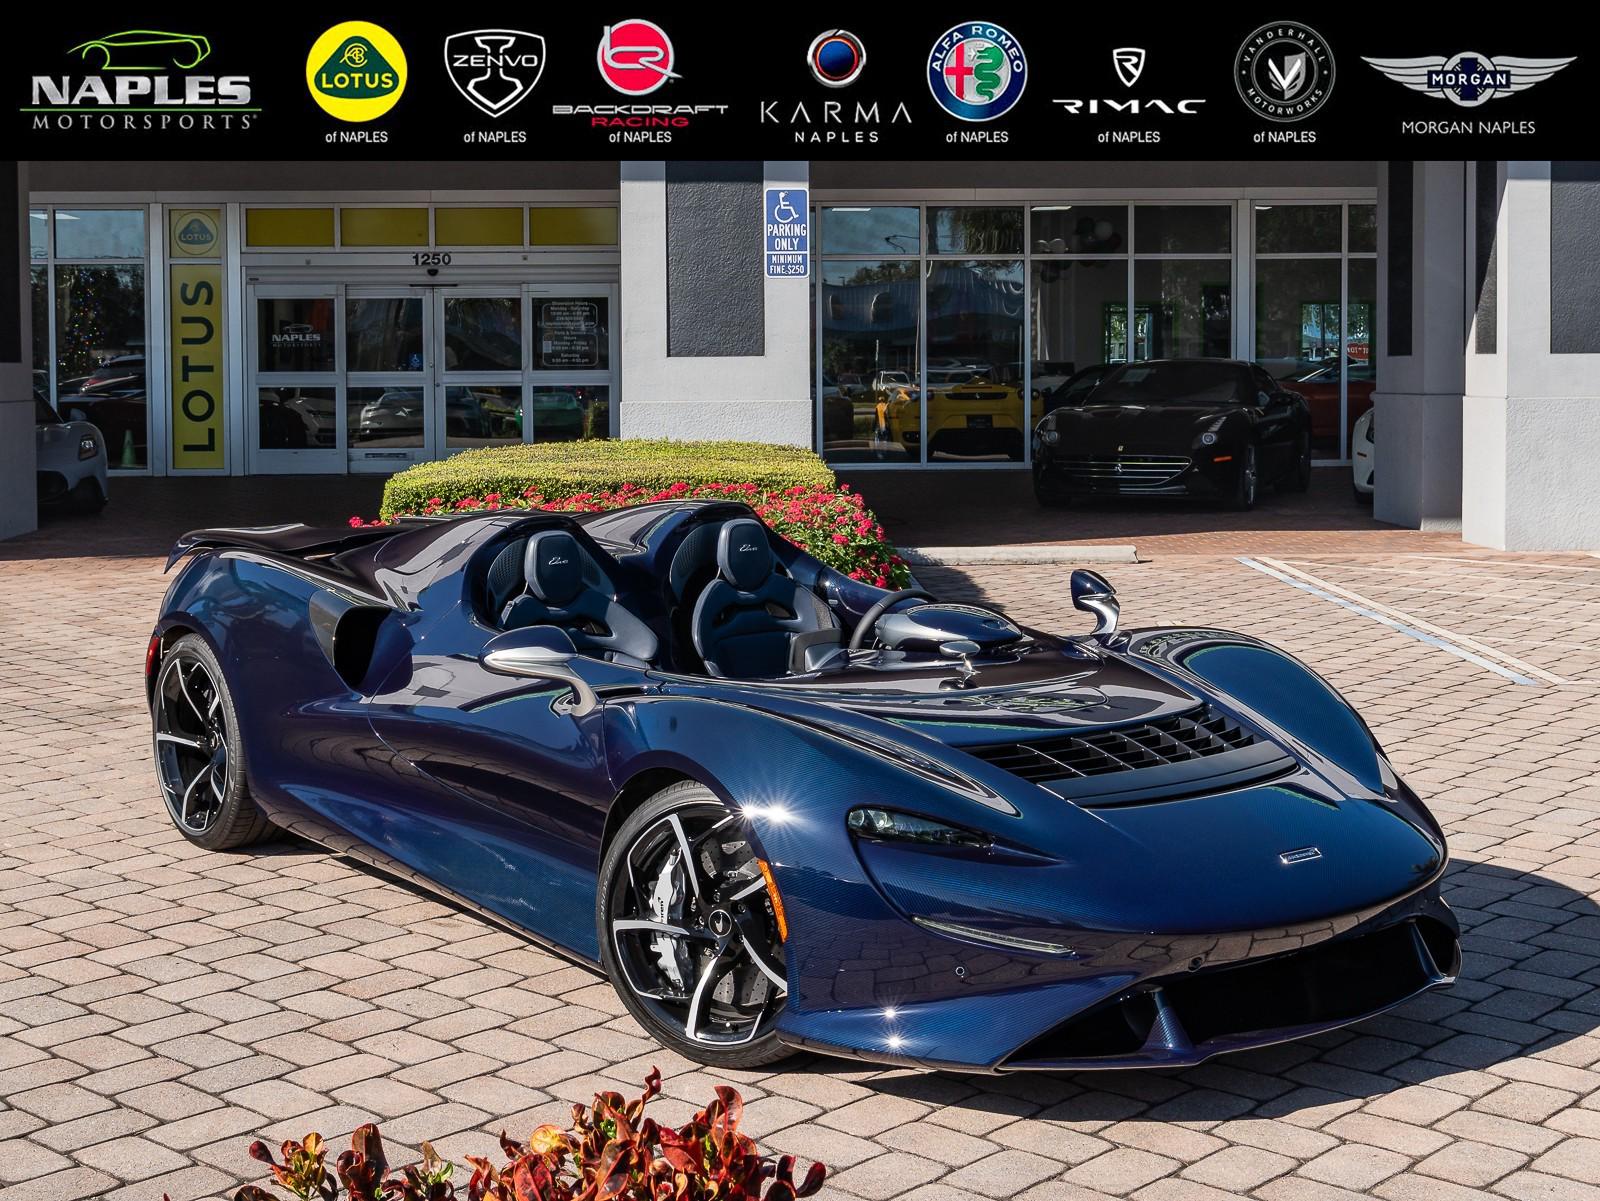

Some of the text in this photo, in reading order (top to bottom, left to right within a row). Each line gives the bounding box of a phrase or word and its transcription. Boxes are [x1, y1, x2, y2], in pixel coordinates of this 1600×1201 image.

[768, 224, 807, 236] PARKING
[181, 233, 213, 241] LOTUS
[774, 238, 799, 250] ONLY
[412, 253, 452, 266] 1250
[772, 255, 802, 264] MINIMUM
[770, 265, 805, 275] FINE $250
[181, 281, 215, 452] LOTUS
